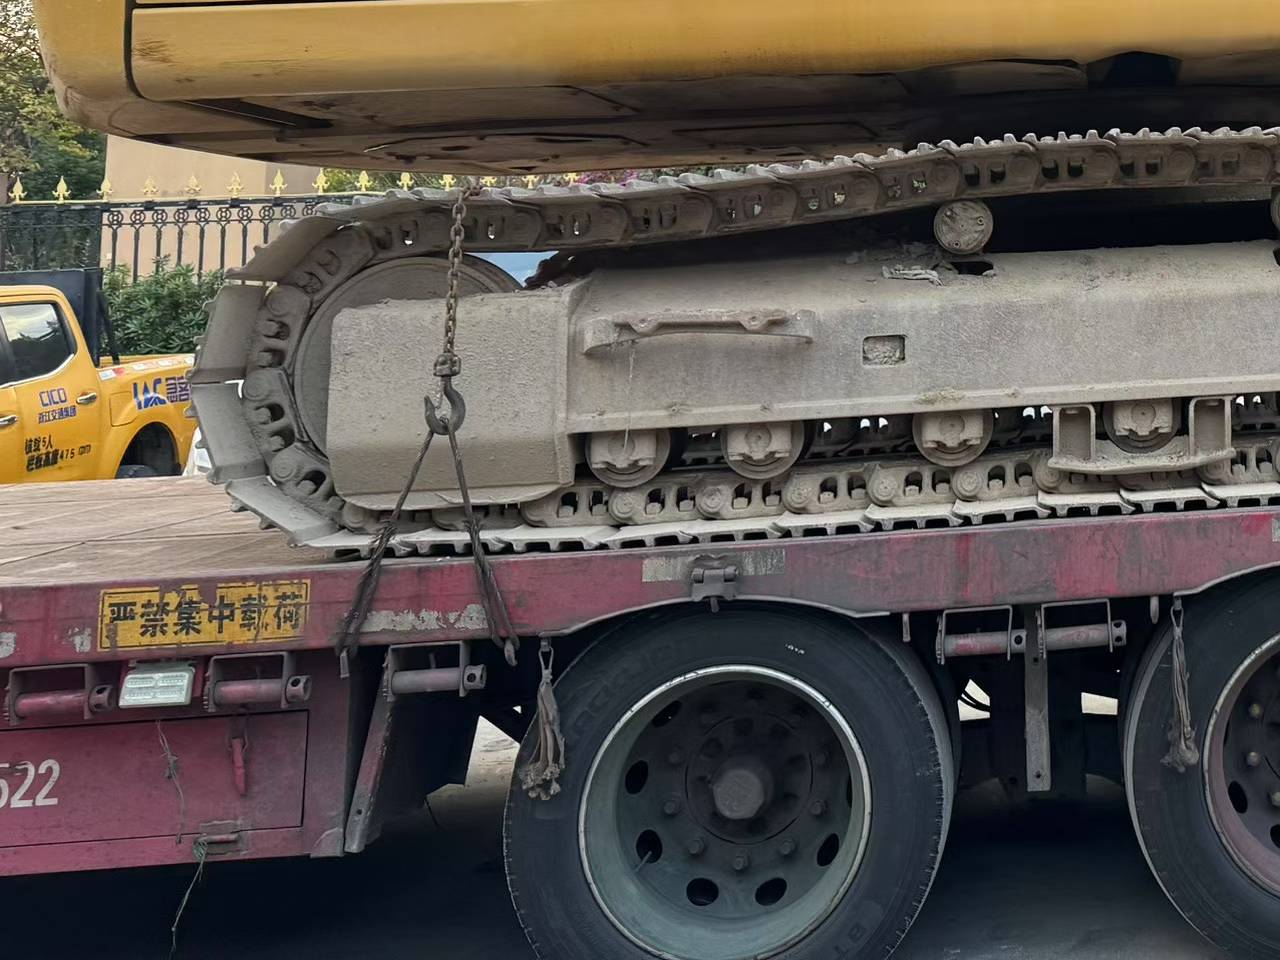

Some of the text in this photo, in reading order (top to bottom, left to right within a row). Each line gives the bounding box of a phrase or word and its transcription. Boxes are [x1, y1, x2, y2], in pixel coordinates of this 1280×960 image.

[106, 592, 304, 639] 严禁集中载荷
